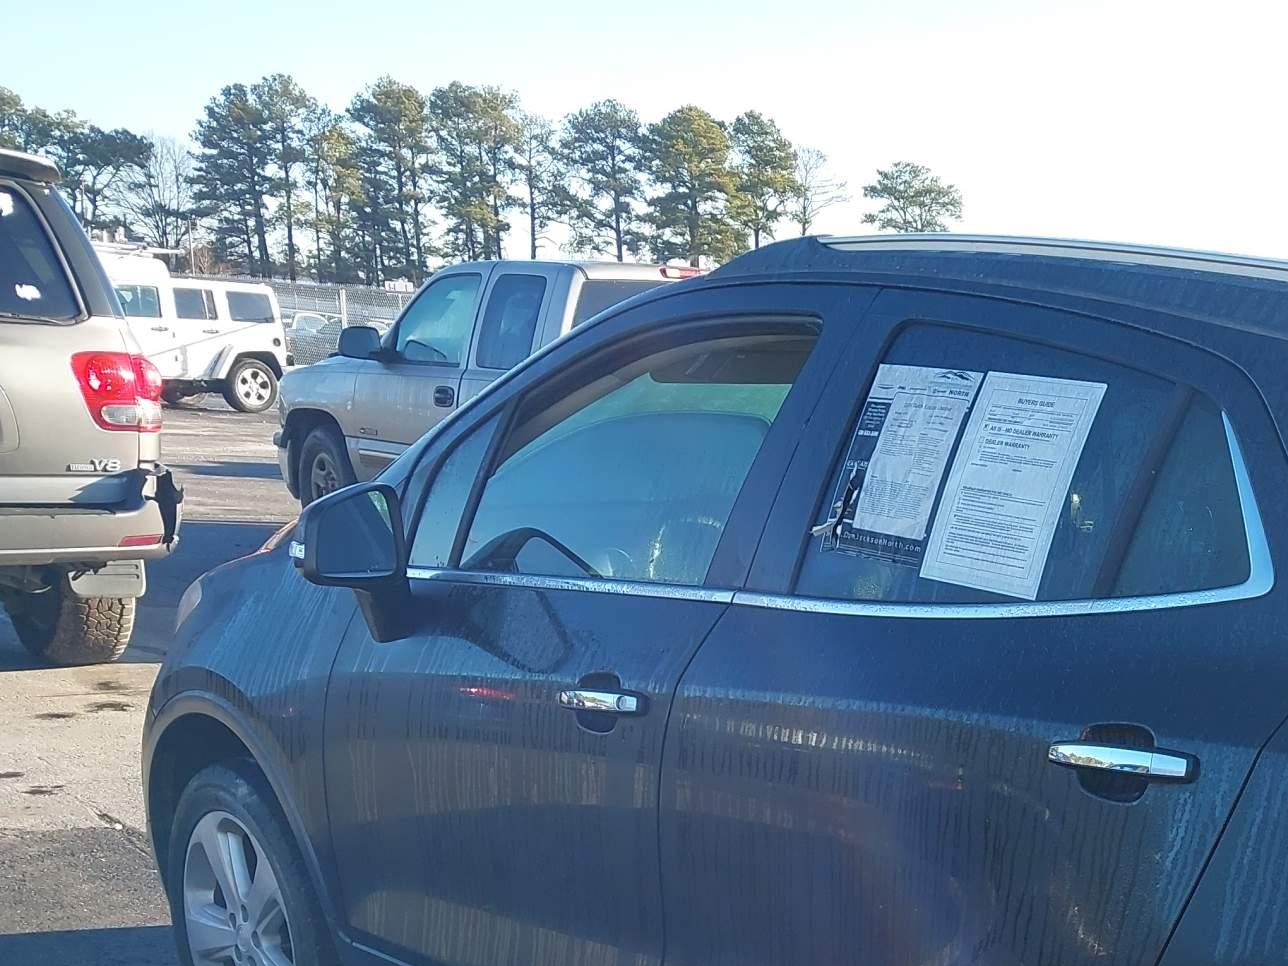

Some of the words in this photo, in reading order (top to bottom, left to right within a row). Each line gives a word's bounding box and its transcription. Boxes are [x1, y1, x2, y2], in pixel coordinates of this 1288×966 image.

[949, 389, 970, 398] NORTH
[1017, 398, 1038, 406] BUYERS
[1038, 400, 1056, 408] GUIDE
[1013, 428, 1032, 437] DEALER
[1031, 430, 1058, 440] WARRANTY
[89, 458, 121, 472] V8
